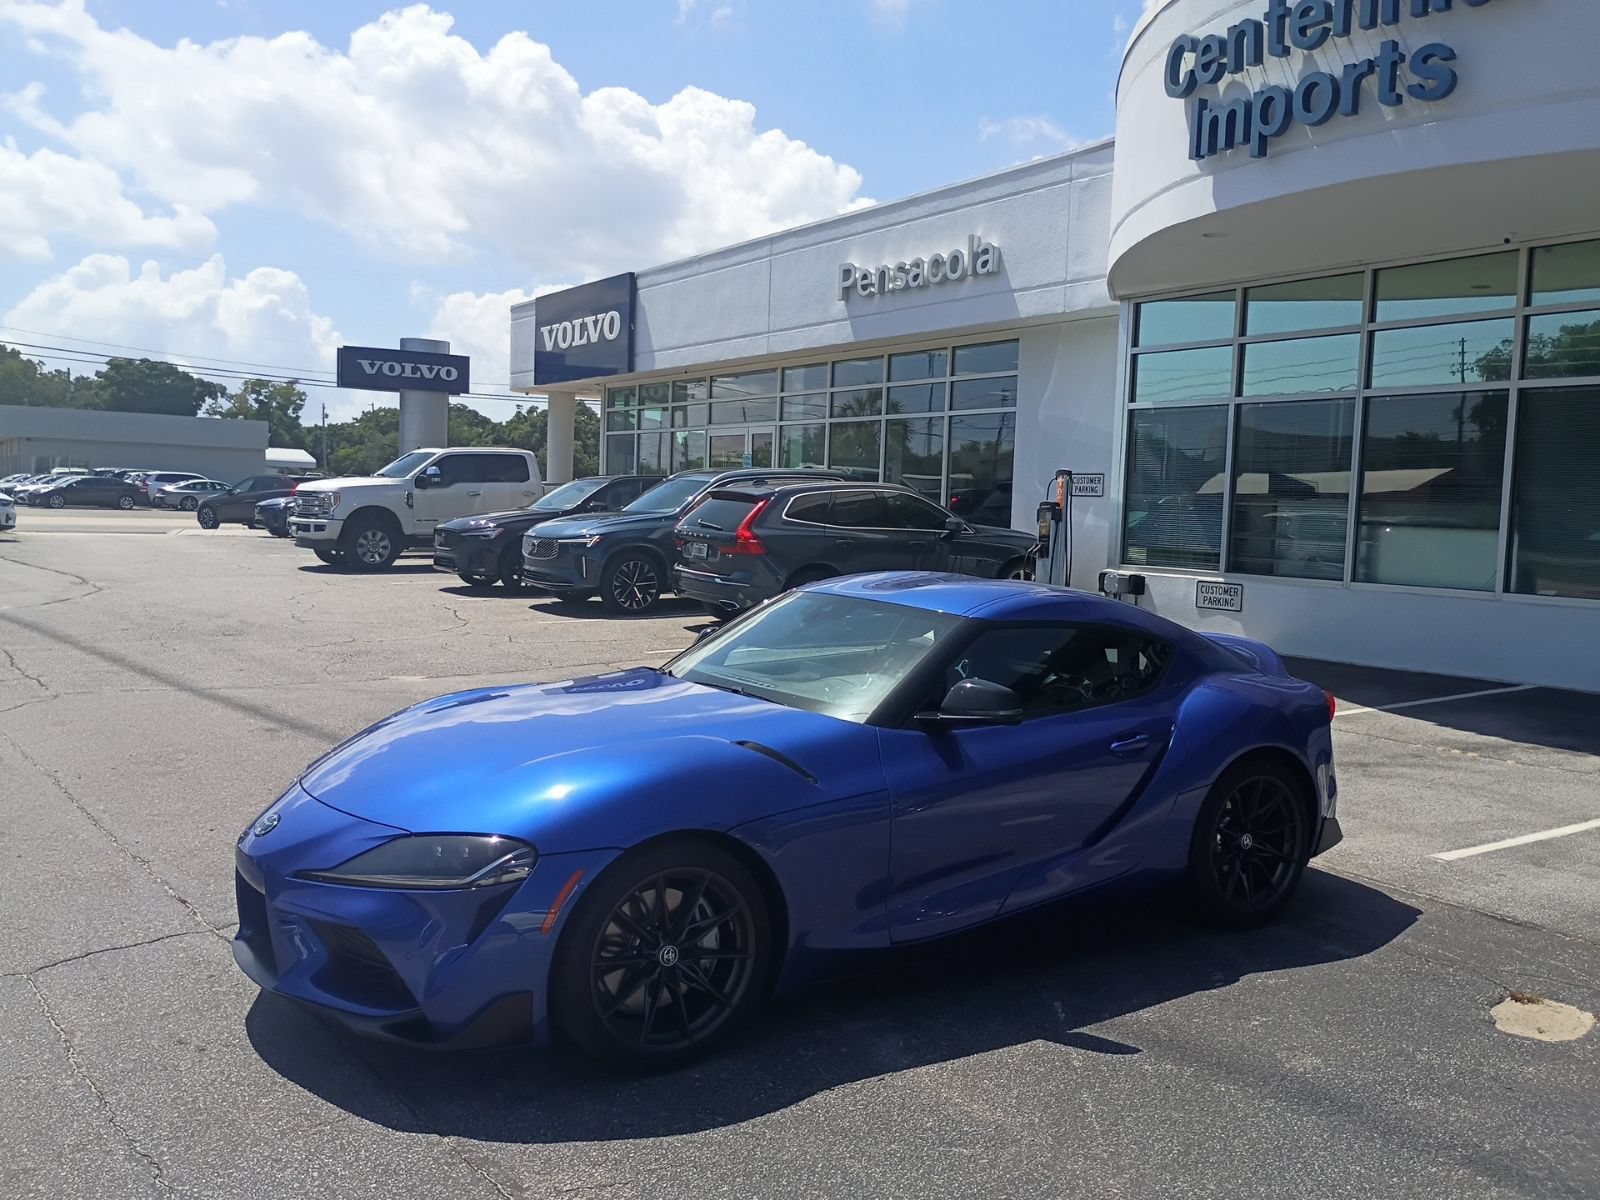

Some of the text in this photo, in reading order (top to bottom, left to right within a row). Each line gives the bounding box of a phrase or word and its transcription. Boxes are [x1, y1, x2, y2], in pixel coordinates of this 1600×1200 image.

[1188, 40, 1457, 160] Imports
[837, 234, 1001, 301] Pensacola
[541, 311, 621, 351] VOLVO
[357, 359, 458, 381] VOLVO
[1072, 476, 1102, 485] CUSTOMER
[1074, 485, 1099, 494] PARKING
[1200, 584, 1239, 597] CUSTOMER
[1203, 595, 1235, 607] PARKING
